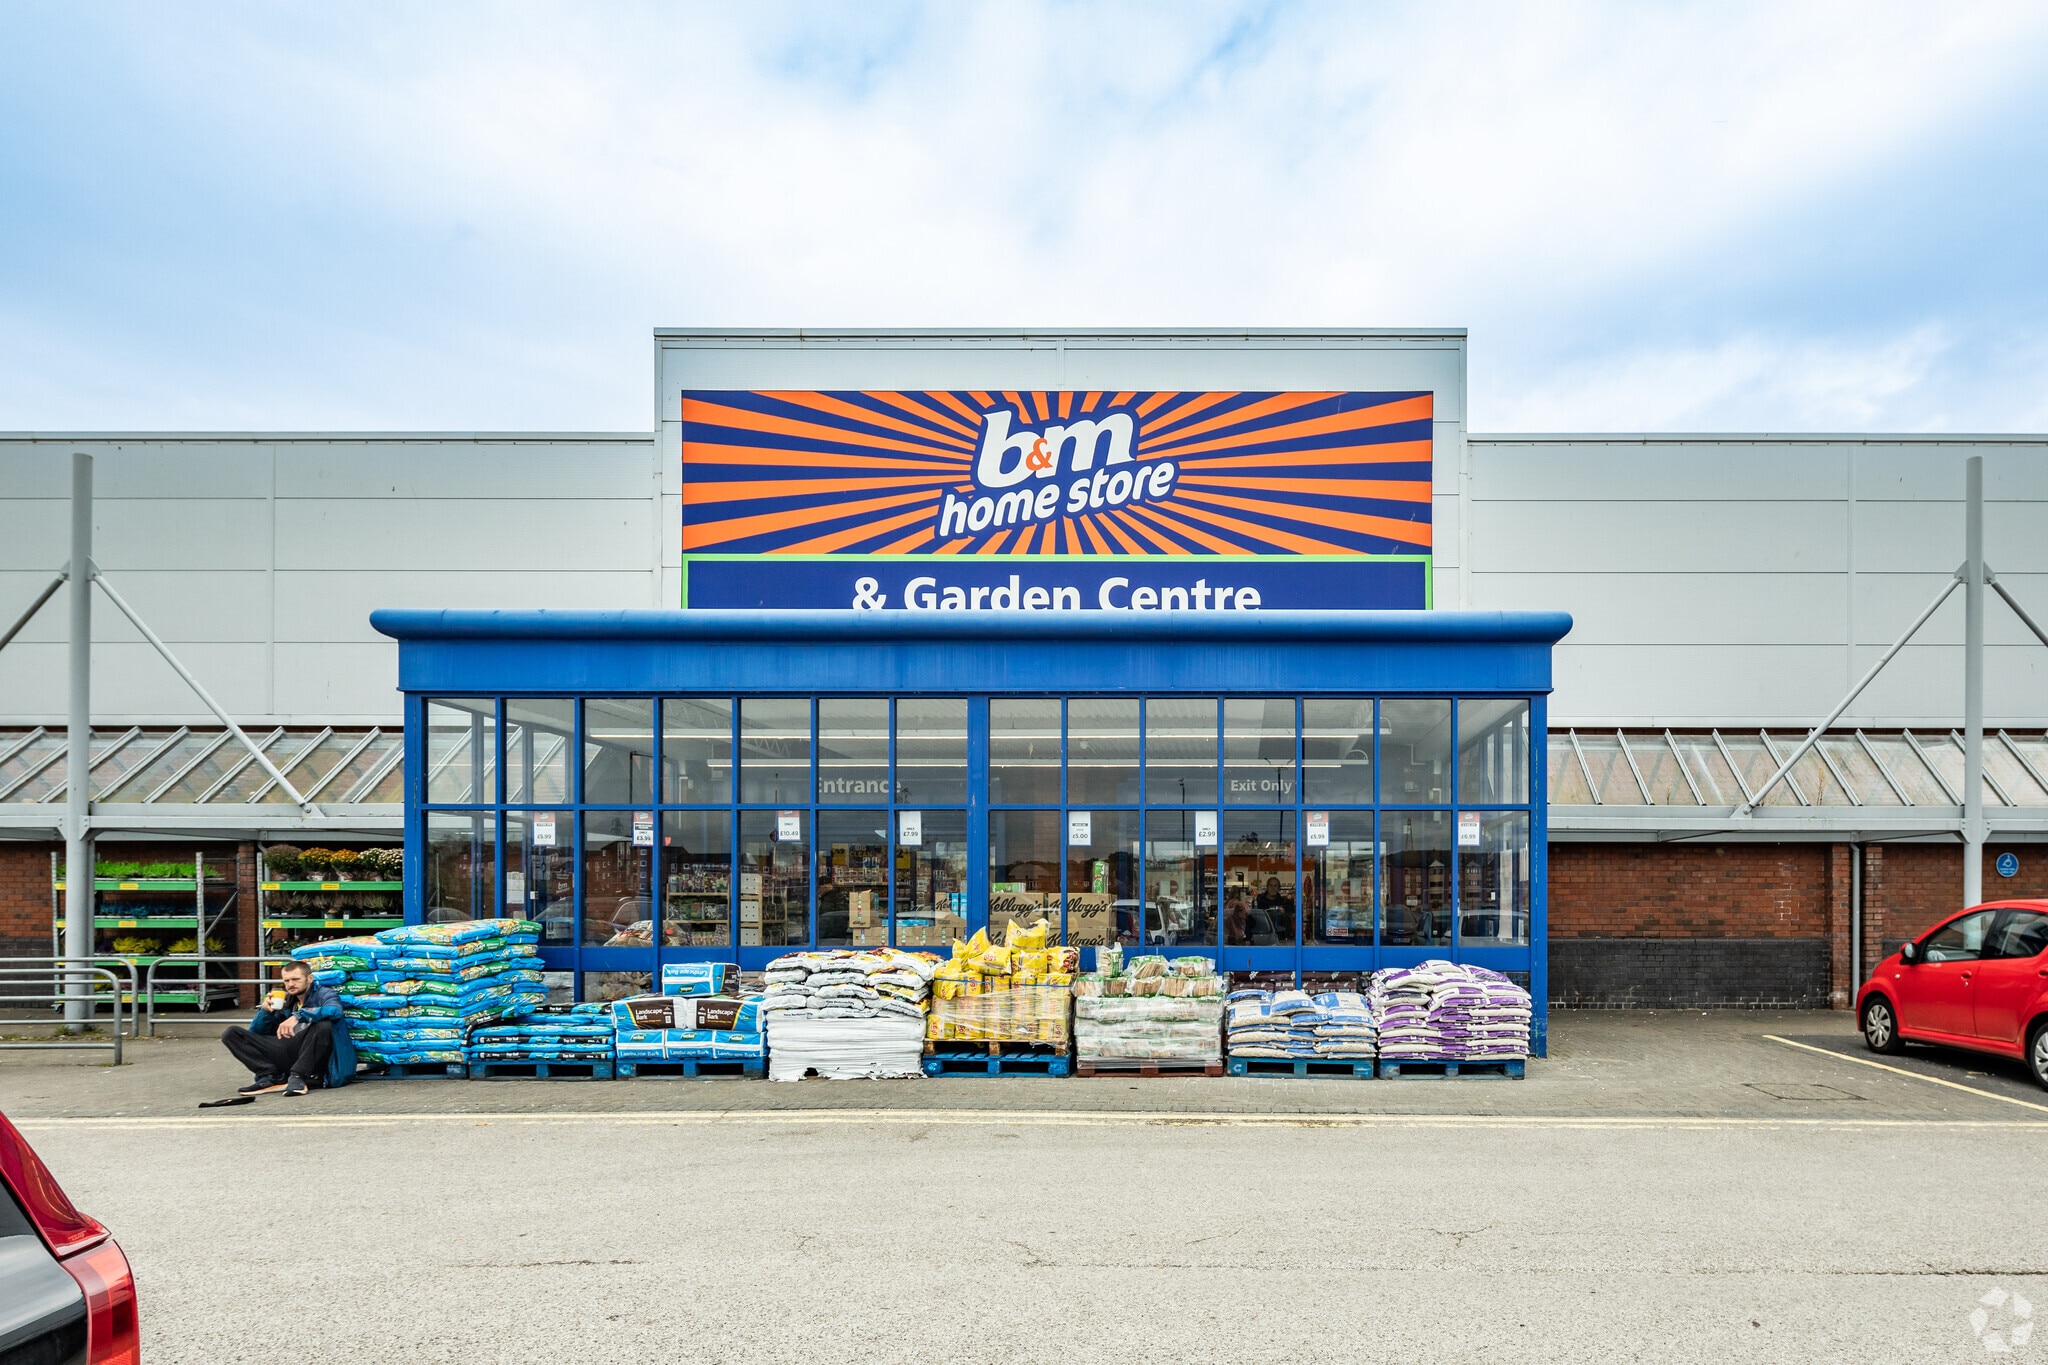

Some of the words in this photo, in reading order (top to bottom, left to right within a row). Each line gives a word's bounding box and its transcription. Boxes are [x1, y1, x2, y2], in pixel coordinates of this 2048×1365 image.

[977, 410, 1136, 488] b&m
[939, 484, 1060, 537] home
[1066, 462, 1175, 513] store
[852, 577, 887, 609] &
[903, 574, 1081, 609] Garden
[1098, 576, 1262, 609] Centre
[1230, 779, 1257, 792] Exit
[1260, 779, 1293, 794] Only
[1049, 896, 1108, 918] Kllogg's
[707, 1008, 734, 1016] Landscape
